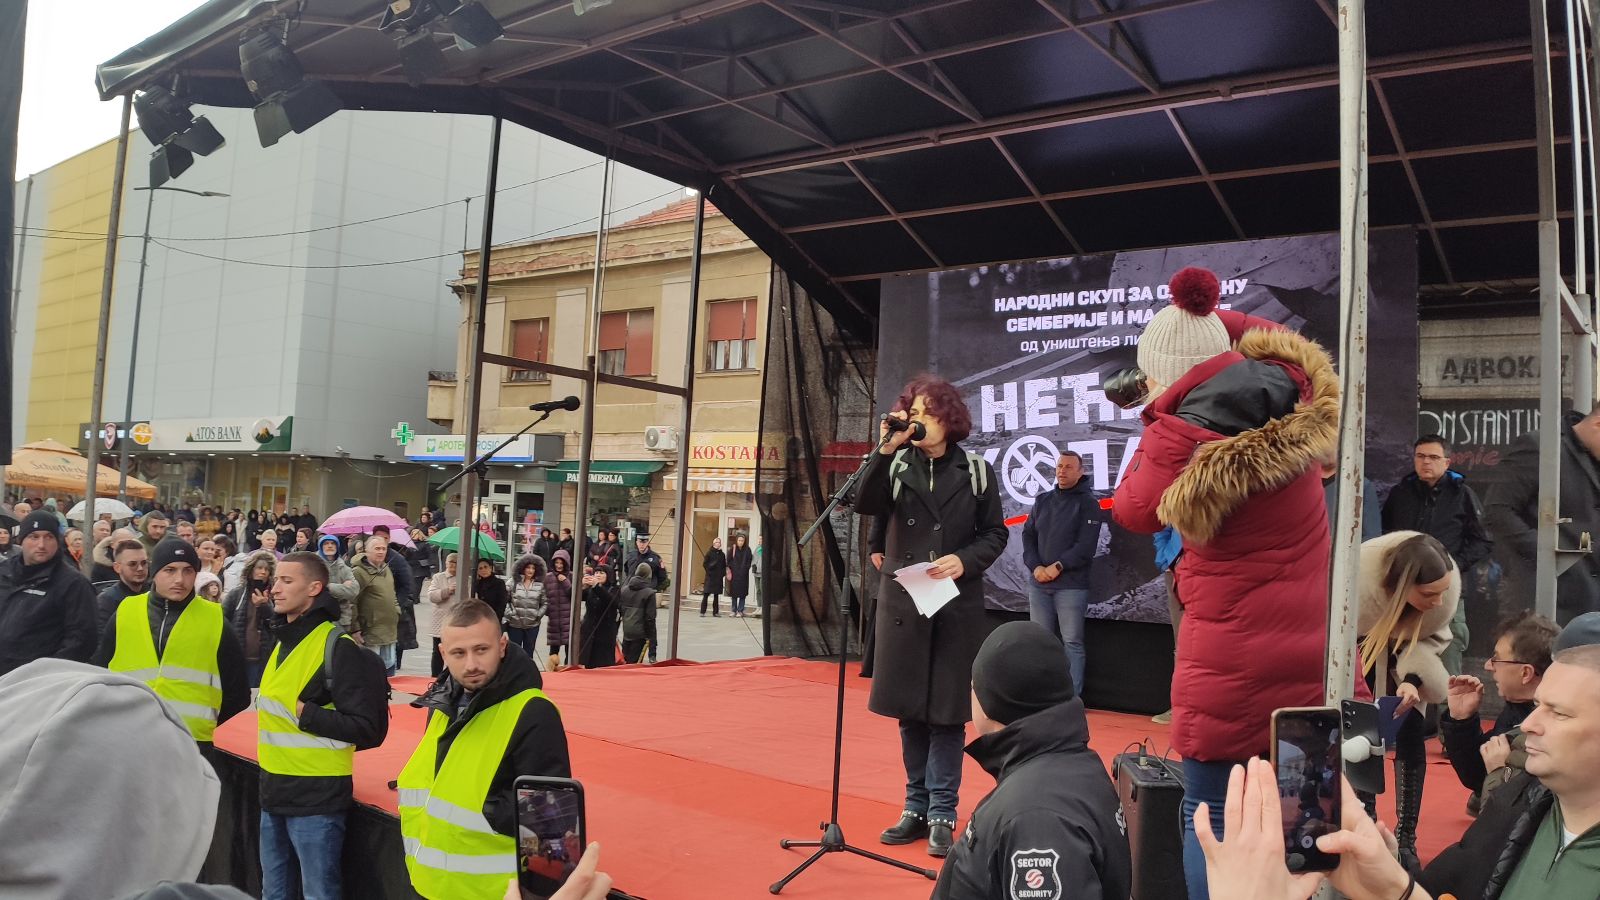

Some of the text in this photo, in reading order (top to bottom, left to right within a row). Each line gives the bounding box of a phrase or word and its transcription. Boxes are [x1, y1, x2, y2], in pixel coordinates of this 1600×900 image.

[995, 293, 1074, 312] НАРОДНИ
[1077, 288, 1125, 306] СКУП
[1128, 286, 1155, 302] ЗА
[1006, 311, 1108, 333] СЕМБЕРИЈЕ
[1111, 311, 1125, 326] И
[1020, 340, 1039, 353] од
[1042, 334, 1120, 355] уништења
[1442, 355, 1570, 384] АДВОКТ
[194, 425, 242, 440] ATOS BANK
[438, 440, 465, 450] APOTEK
[1017, 858, 1053, 868] SECTOR
[1018, 889, 1053, 899] SECURITY
